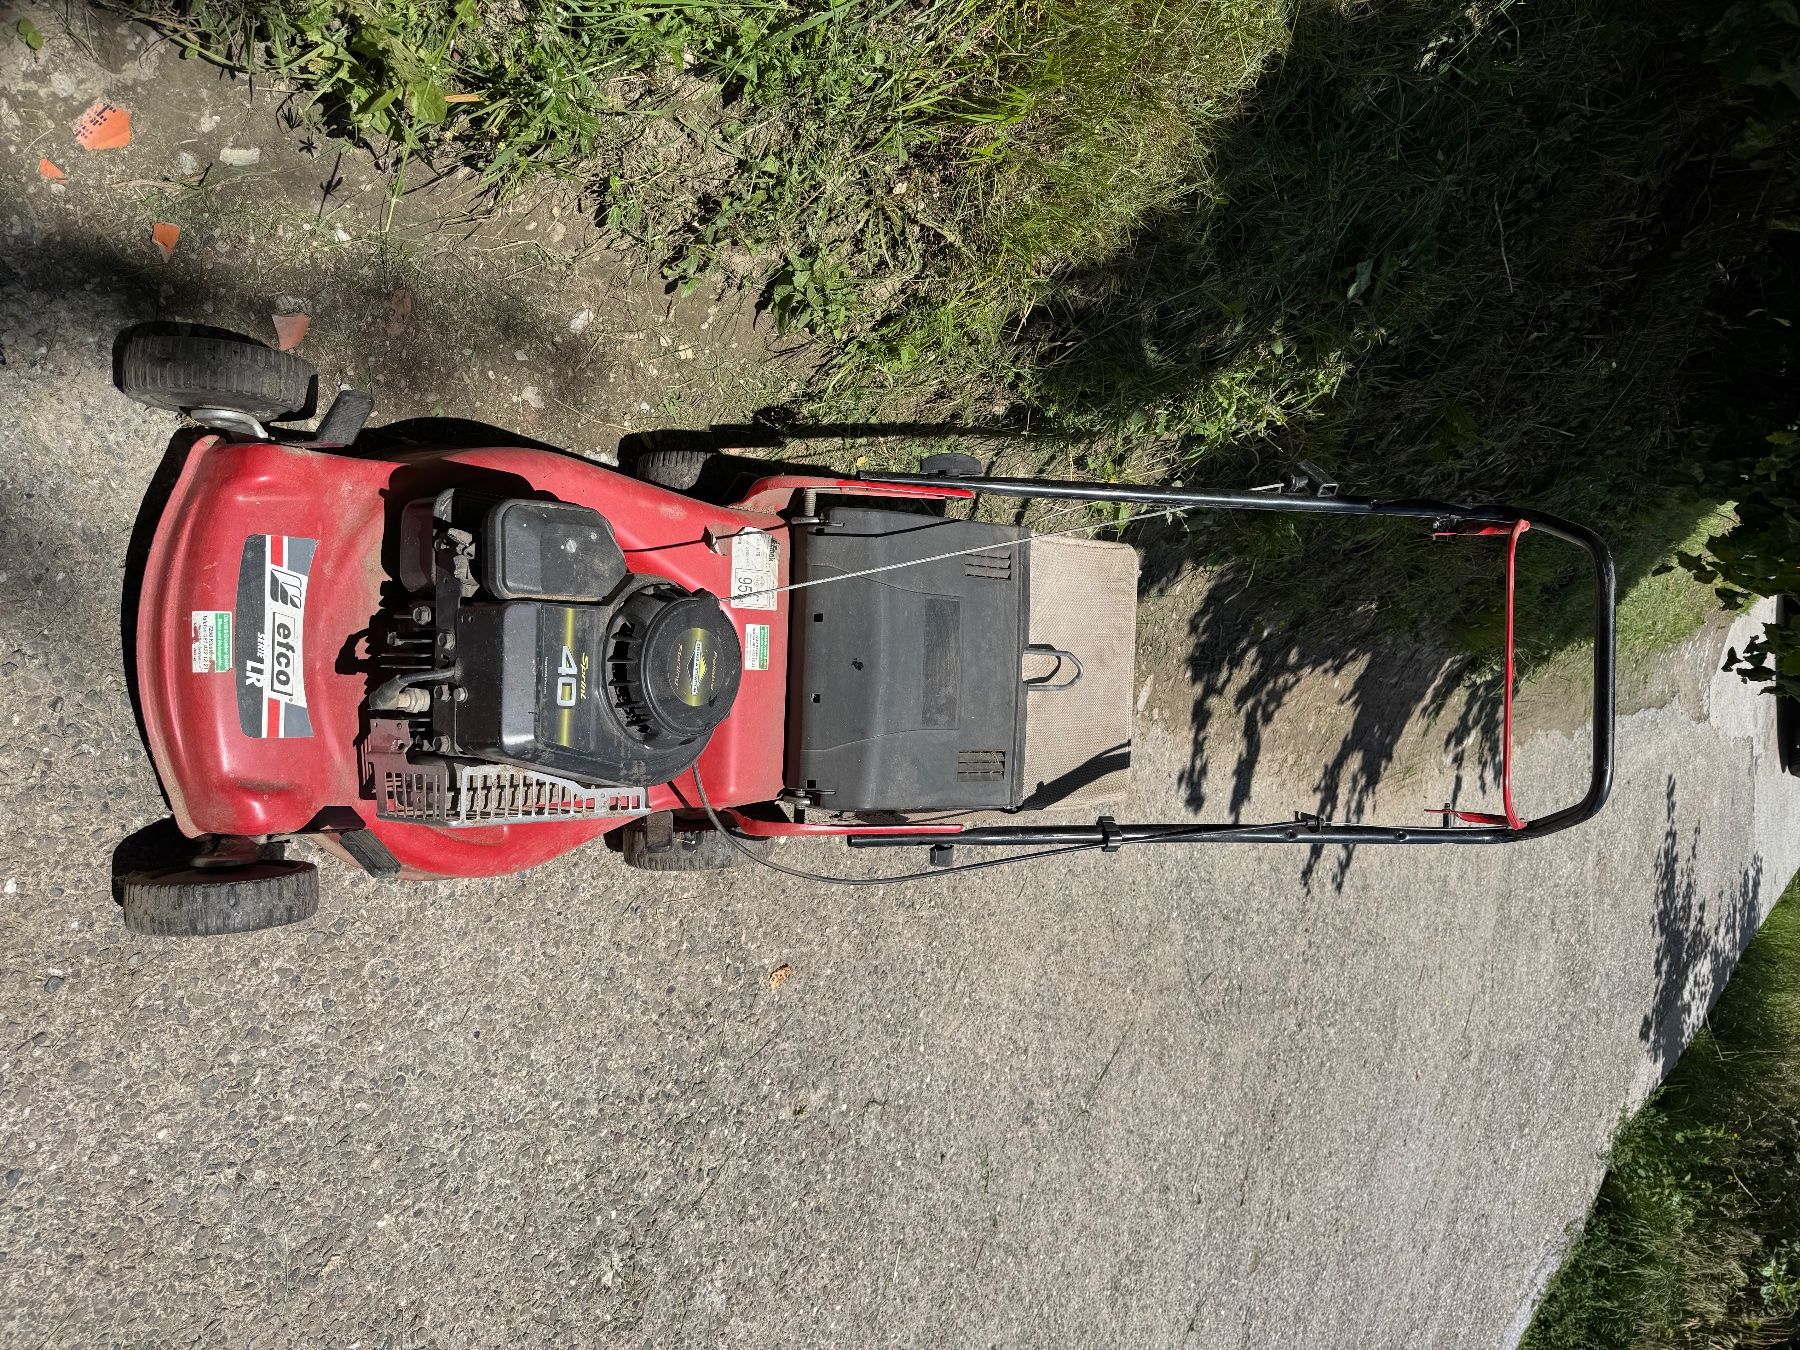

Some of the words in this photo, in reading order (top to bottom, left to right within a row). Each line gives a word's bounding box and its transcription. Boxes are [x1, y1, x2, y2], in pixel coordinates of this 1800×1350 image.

[738, 577, 753, 593] 95
[257, 632, 265, 659] SERIE
[275, 622, 295, 686] efco
[245, 660, 264, 687] LR
[556, 645, 578, 707] 40
[580, 652, 589, 700] Sprint
